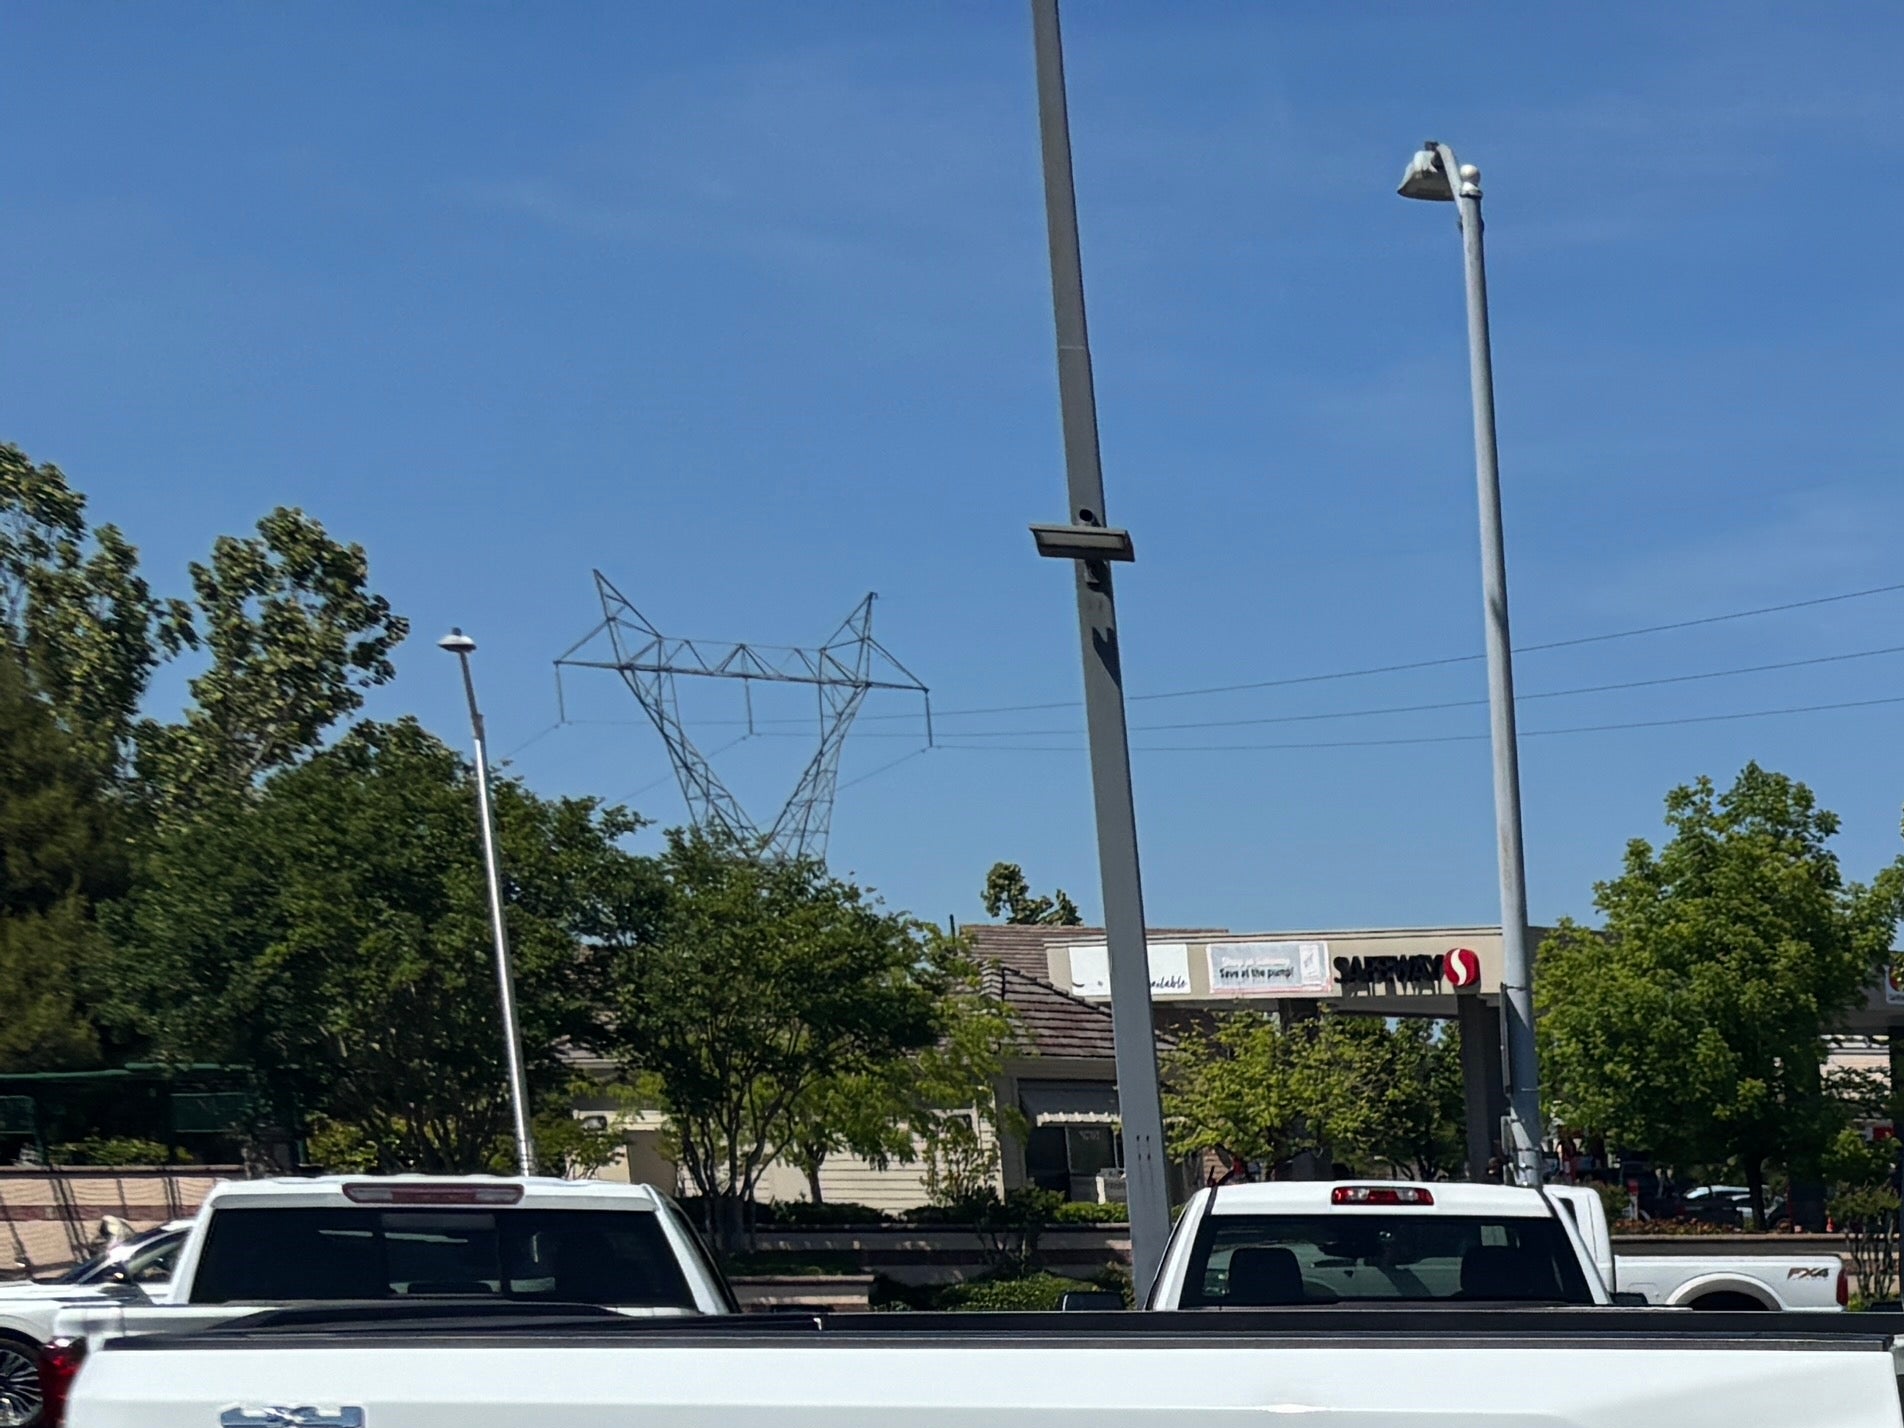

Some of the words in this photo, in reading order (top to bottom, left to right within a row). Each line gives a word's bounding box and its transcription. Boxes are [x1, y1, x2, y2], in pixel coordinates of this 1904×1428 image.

[1251, 968, 1265, 978] the
[1334, 954, 1446, 983] SAFEWAY
[1787, 1267, 1829, 1280] FX4
